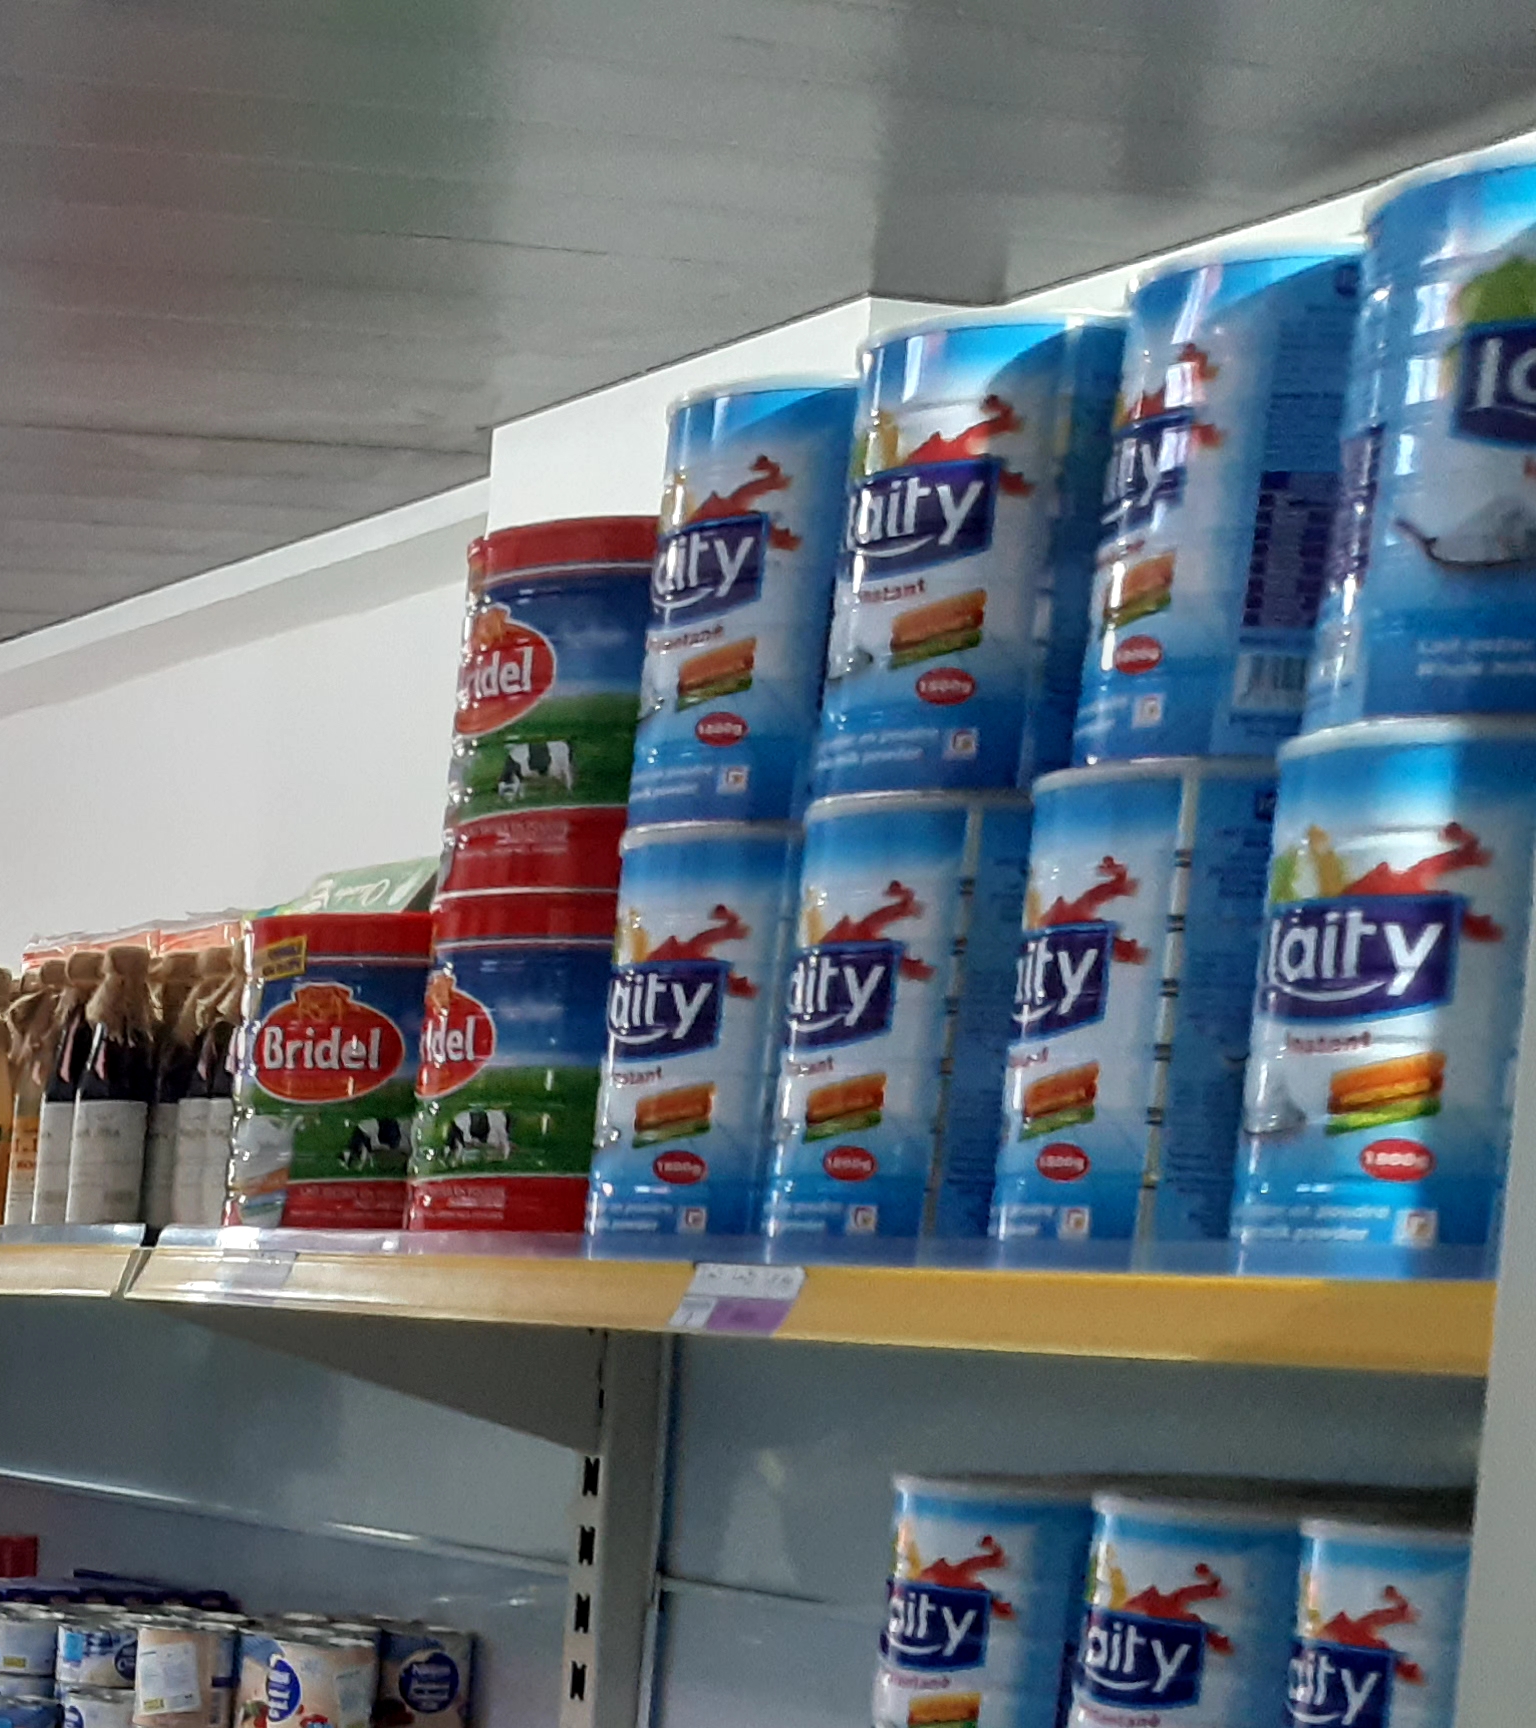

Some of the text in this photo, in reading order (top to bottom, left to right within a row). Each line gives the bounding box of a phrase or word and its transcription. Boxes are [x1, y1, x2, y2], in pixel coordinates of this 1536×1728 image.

[1271, 910, 1444, 996] laity
[263, 1024, 381, 1071] Bridel
[1086, 1624, 1193, 1693] aity
